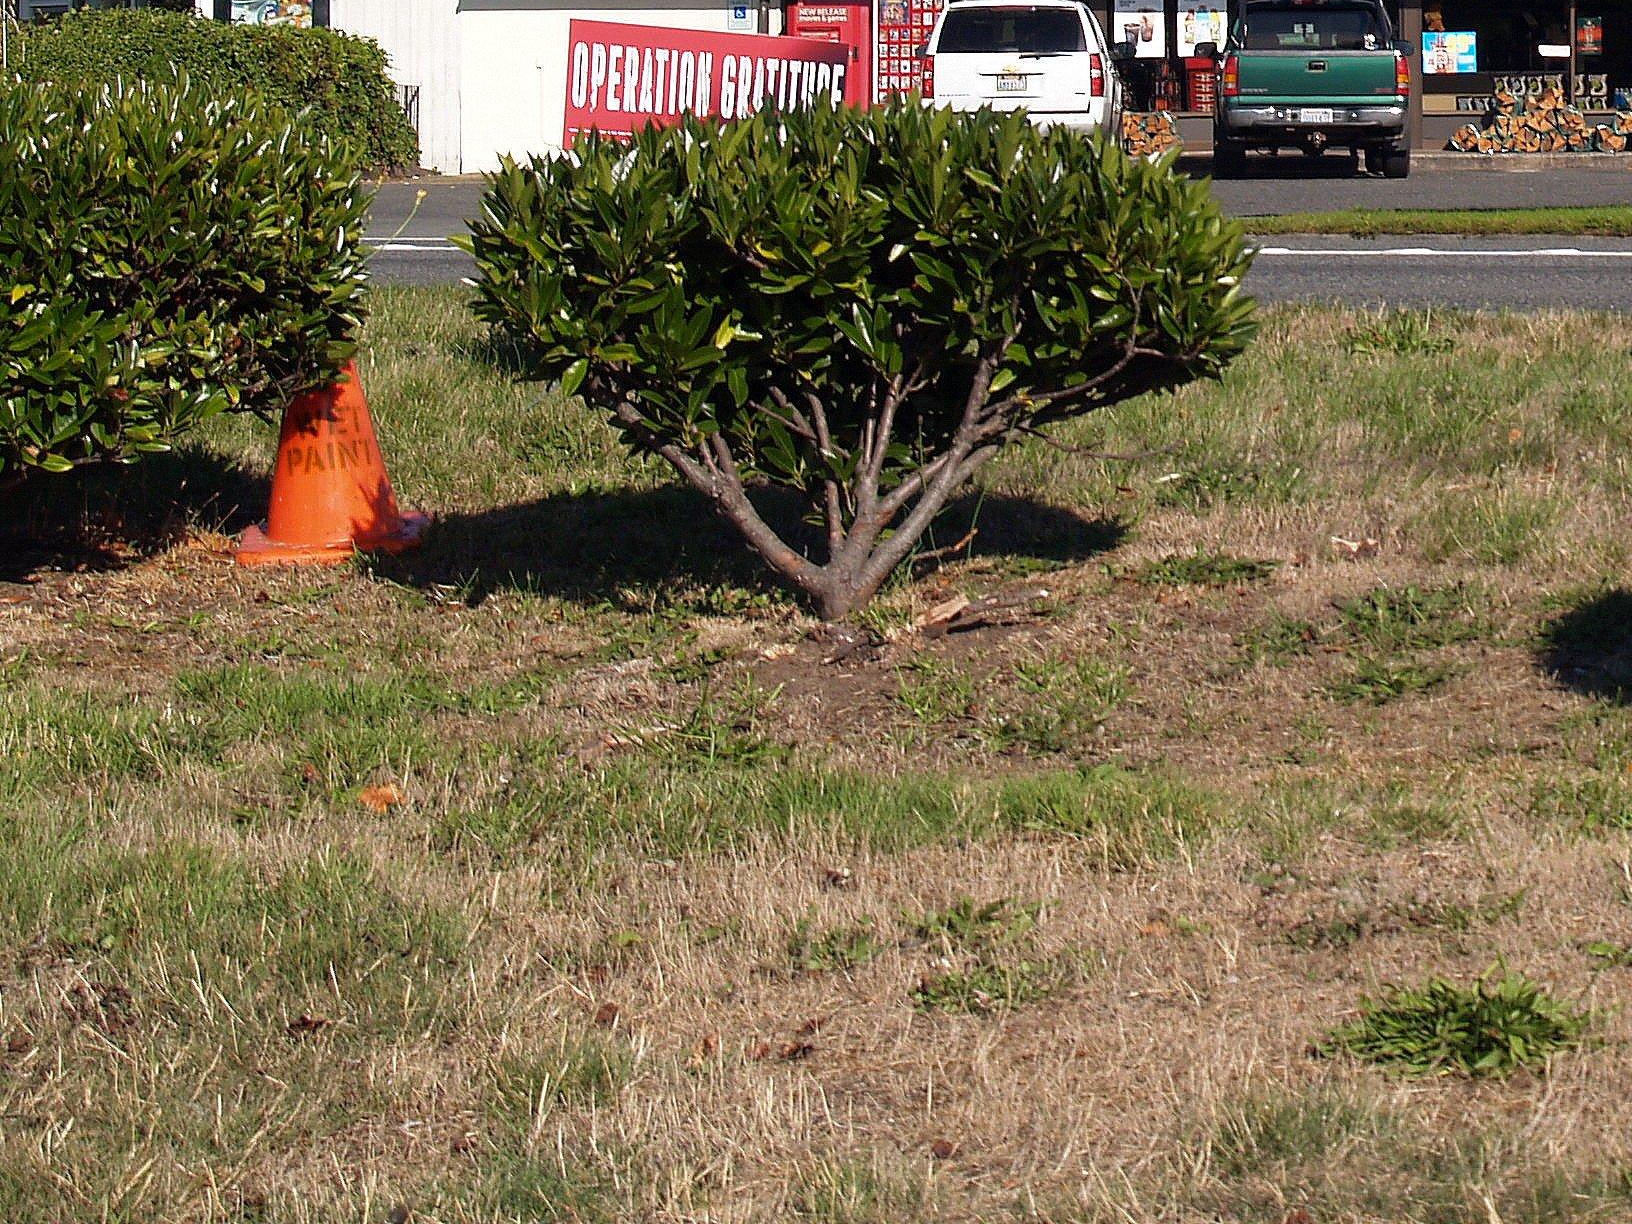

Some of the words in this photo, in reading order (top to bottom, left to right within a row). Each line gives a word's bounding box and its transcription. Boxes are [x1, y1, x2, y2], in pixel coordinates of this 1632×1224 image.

[571, 40, 713, 118] OPERATION
[720, 54, 845, 120] GRATITUDE
[287, 438, 372, 476] PAINT
